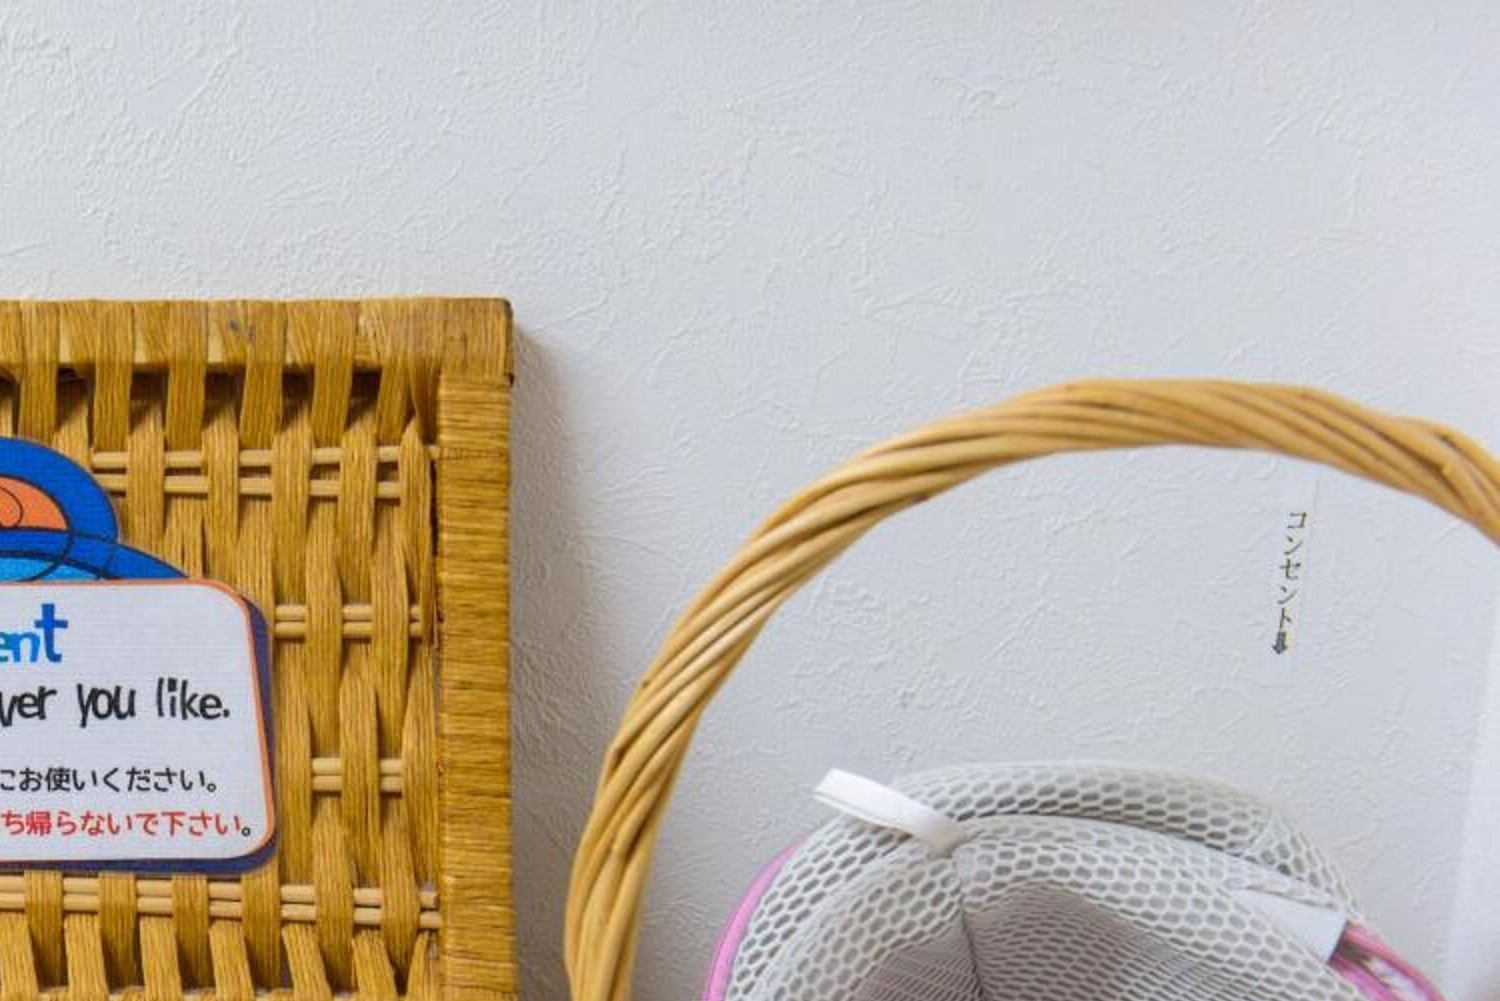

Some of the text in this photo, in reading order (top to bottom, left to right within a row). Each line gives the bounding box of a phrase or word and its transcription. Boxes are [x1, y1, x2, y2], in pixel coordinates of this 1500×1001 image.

[1277, 511, 1307, 630] コンセント
[77, 683, 136, 728] you
[156, 677, 231, 721] like.
